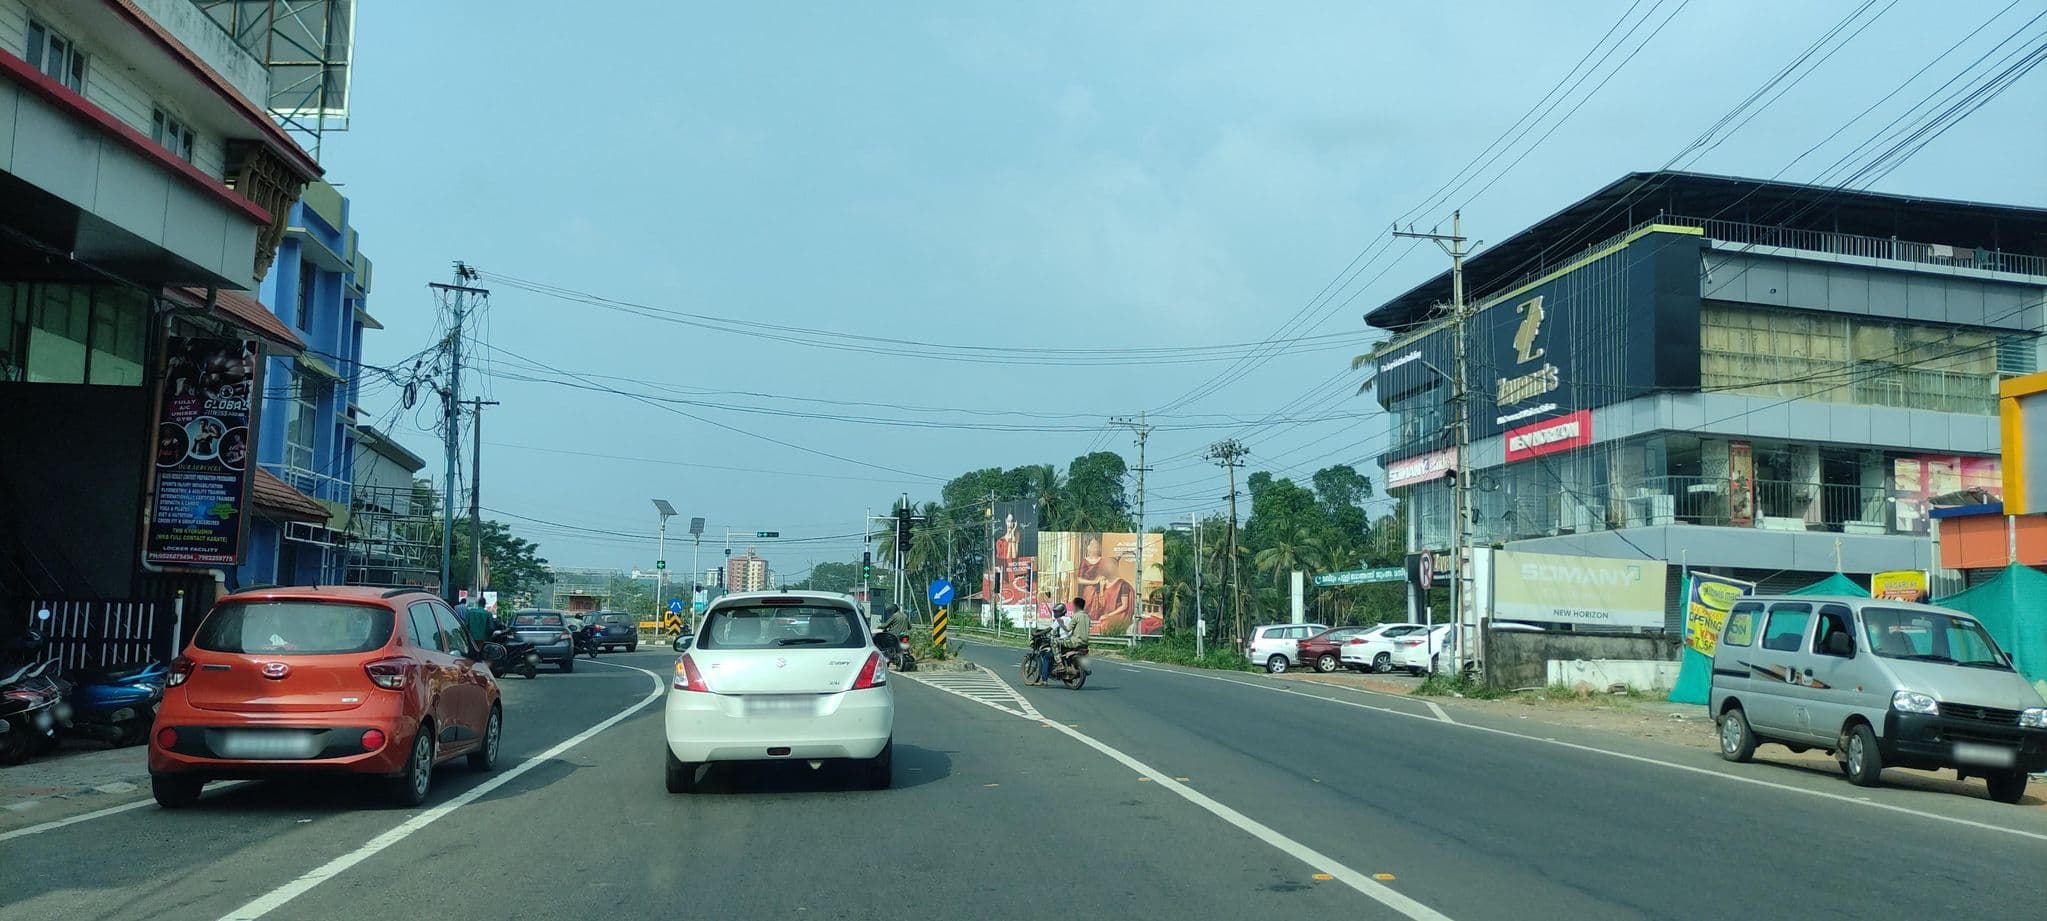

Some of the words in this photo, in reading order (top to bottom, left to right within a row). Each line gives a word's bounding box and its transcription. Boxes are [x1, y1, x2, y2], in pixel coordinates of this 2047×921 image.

[204, 399, 250, 411] GLOBAL
[1520, 562, 1635, 587] SOMANY
[1553, 609, 1572, 617] NEW
[1573, 610, 1609, 619] HORIZON
